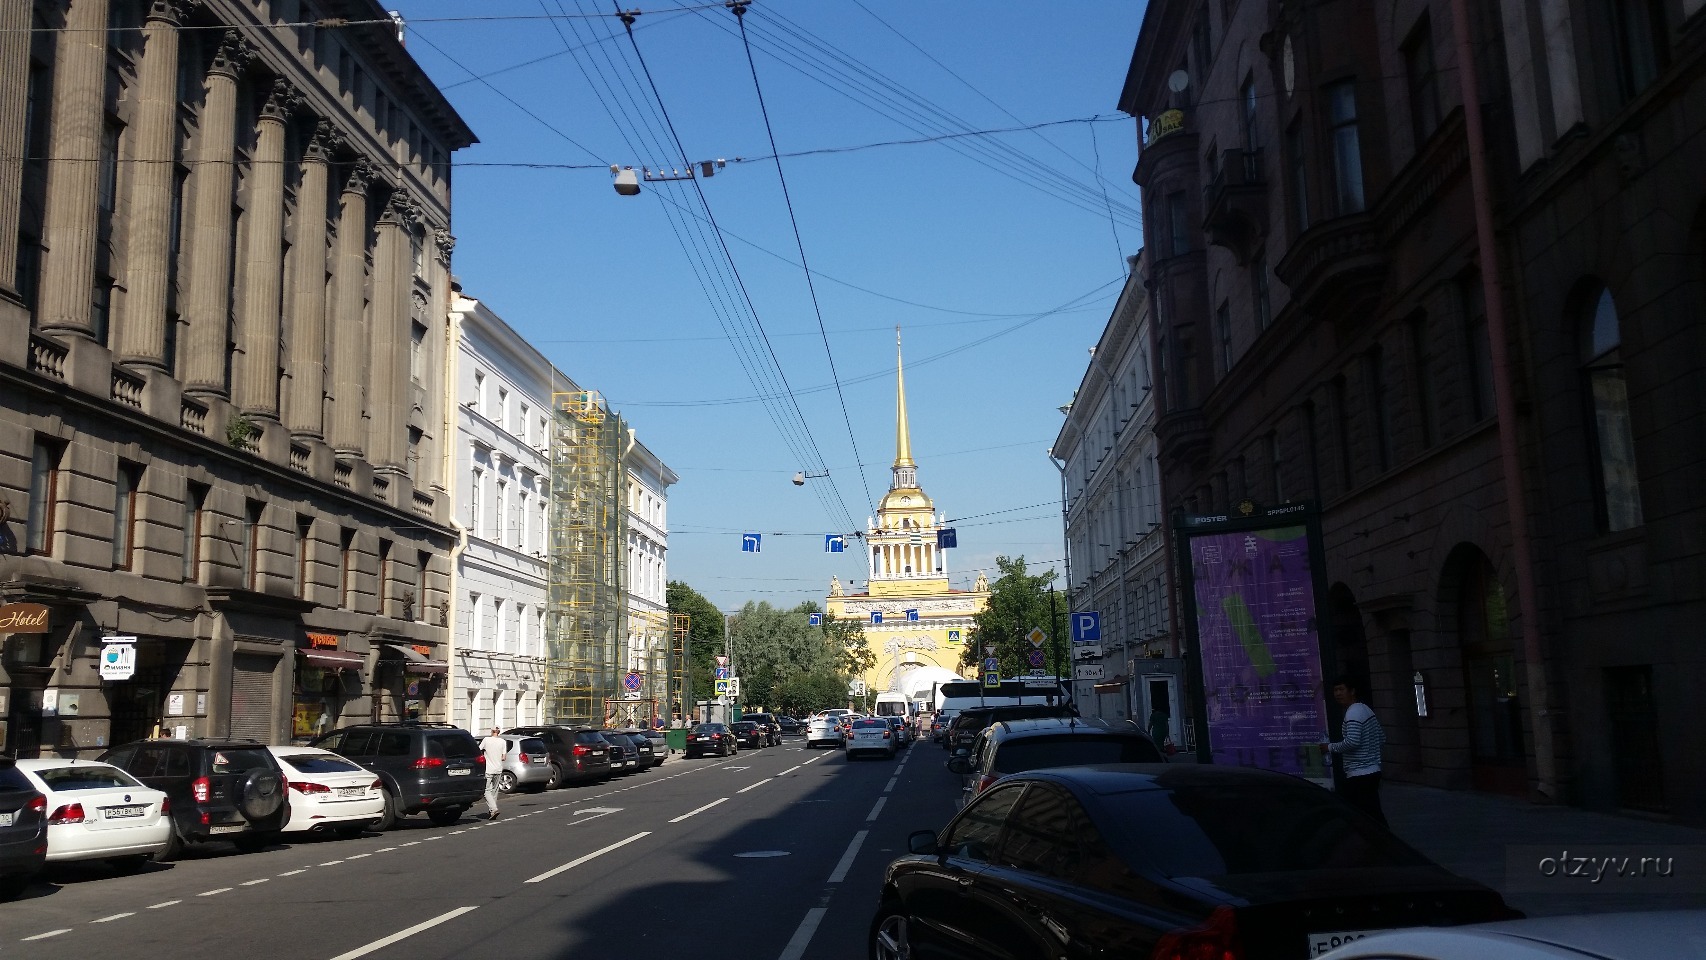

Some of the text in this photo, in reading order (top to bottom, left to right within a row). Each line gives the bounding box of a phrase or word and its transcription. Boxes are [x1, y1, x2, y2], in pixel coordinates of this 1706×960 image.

[1195, 515, 1228, 524] POSTER
[0, 609, 47, 628] Hotel
[1079, 615, 1095, 639] P
